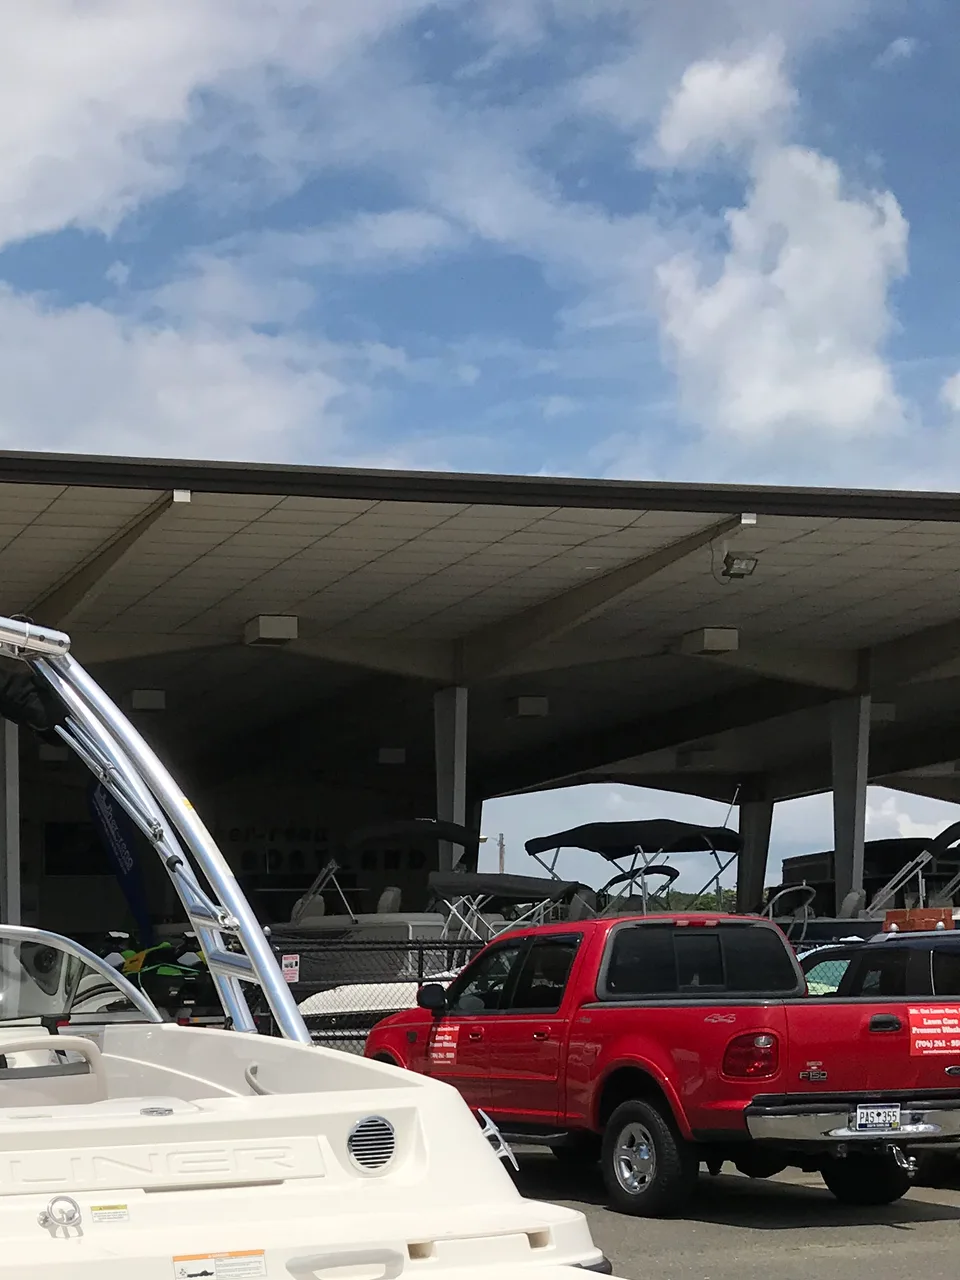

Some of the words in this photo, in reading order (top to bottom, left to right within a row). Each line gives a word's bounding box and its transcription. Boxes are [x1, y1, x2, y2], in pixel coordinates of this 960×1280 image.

[915, 1040, 933, 1048] (704)
[860, 1111, 875, 1123] PAS
[882, 1110, 897, 1123] 355
